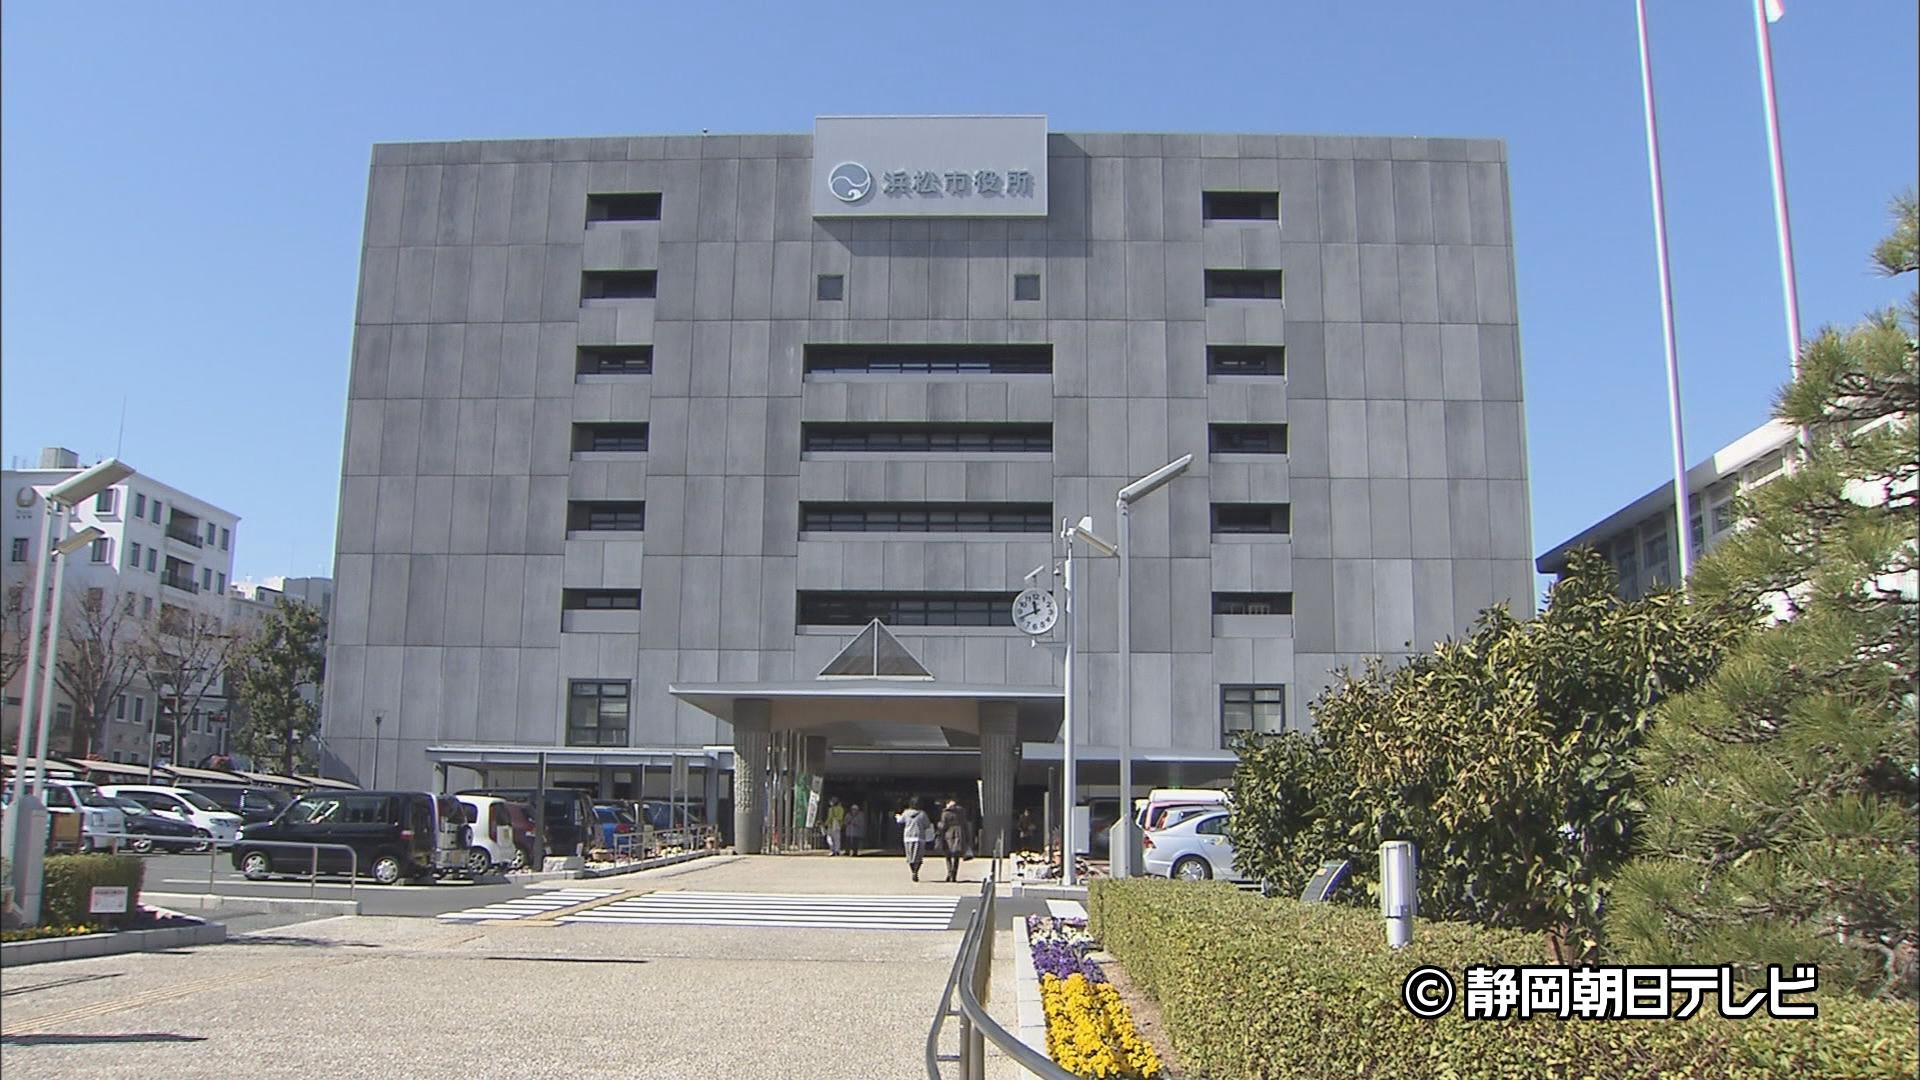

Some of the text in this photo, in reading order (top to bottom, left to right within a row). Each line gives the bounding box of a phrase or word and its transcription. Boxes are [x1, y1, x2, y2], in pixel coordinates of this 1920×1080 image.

[882, 168, 1033, 197] 浜松市役所
